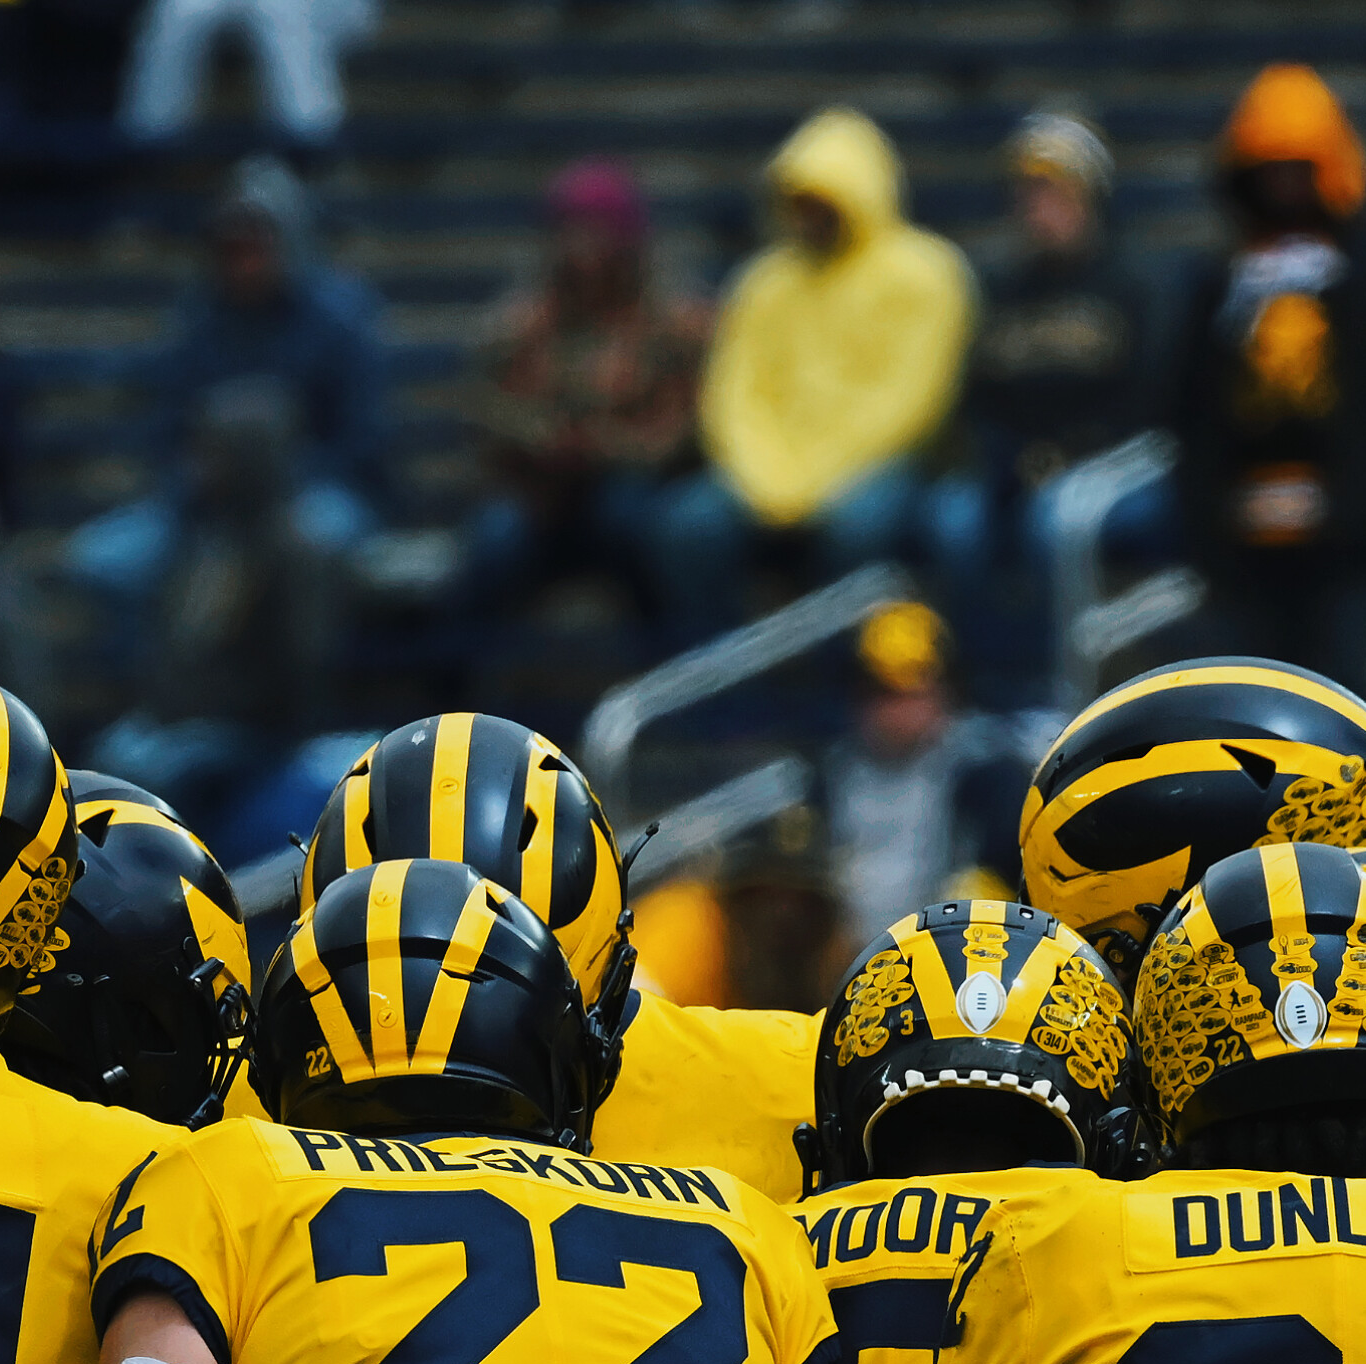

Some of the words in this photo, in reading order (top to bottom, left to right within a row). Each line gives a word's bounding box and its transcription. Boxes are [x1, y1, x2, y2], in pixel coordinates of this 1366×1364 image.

[900, 1009, 914, 1036] 3
[1235, 1011, 1267, 1026] RAMPAGE
[306, 1046, 331, 1078] 22
[1214, 1034, 1245, 1066] 22
[1187, 1061, 1211, 1081] TED
